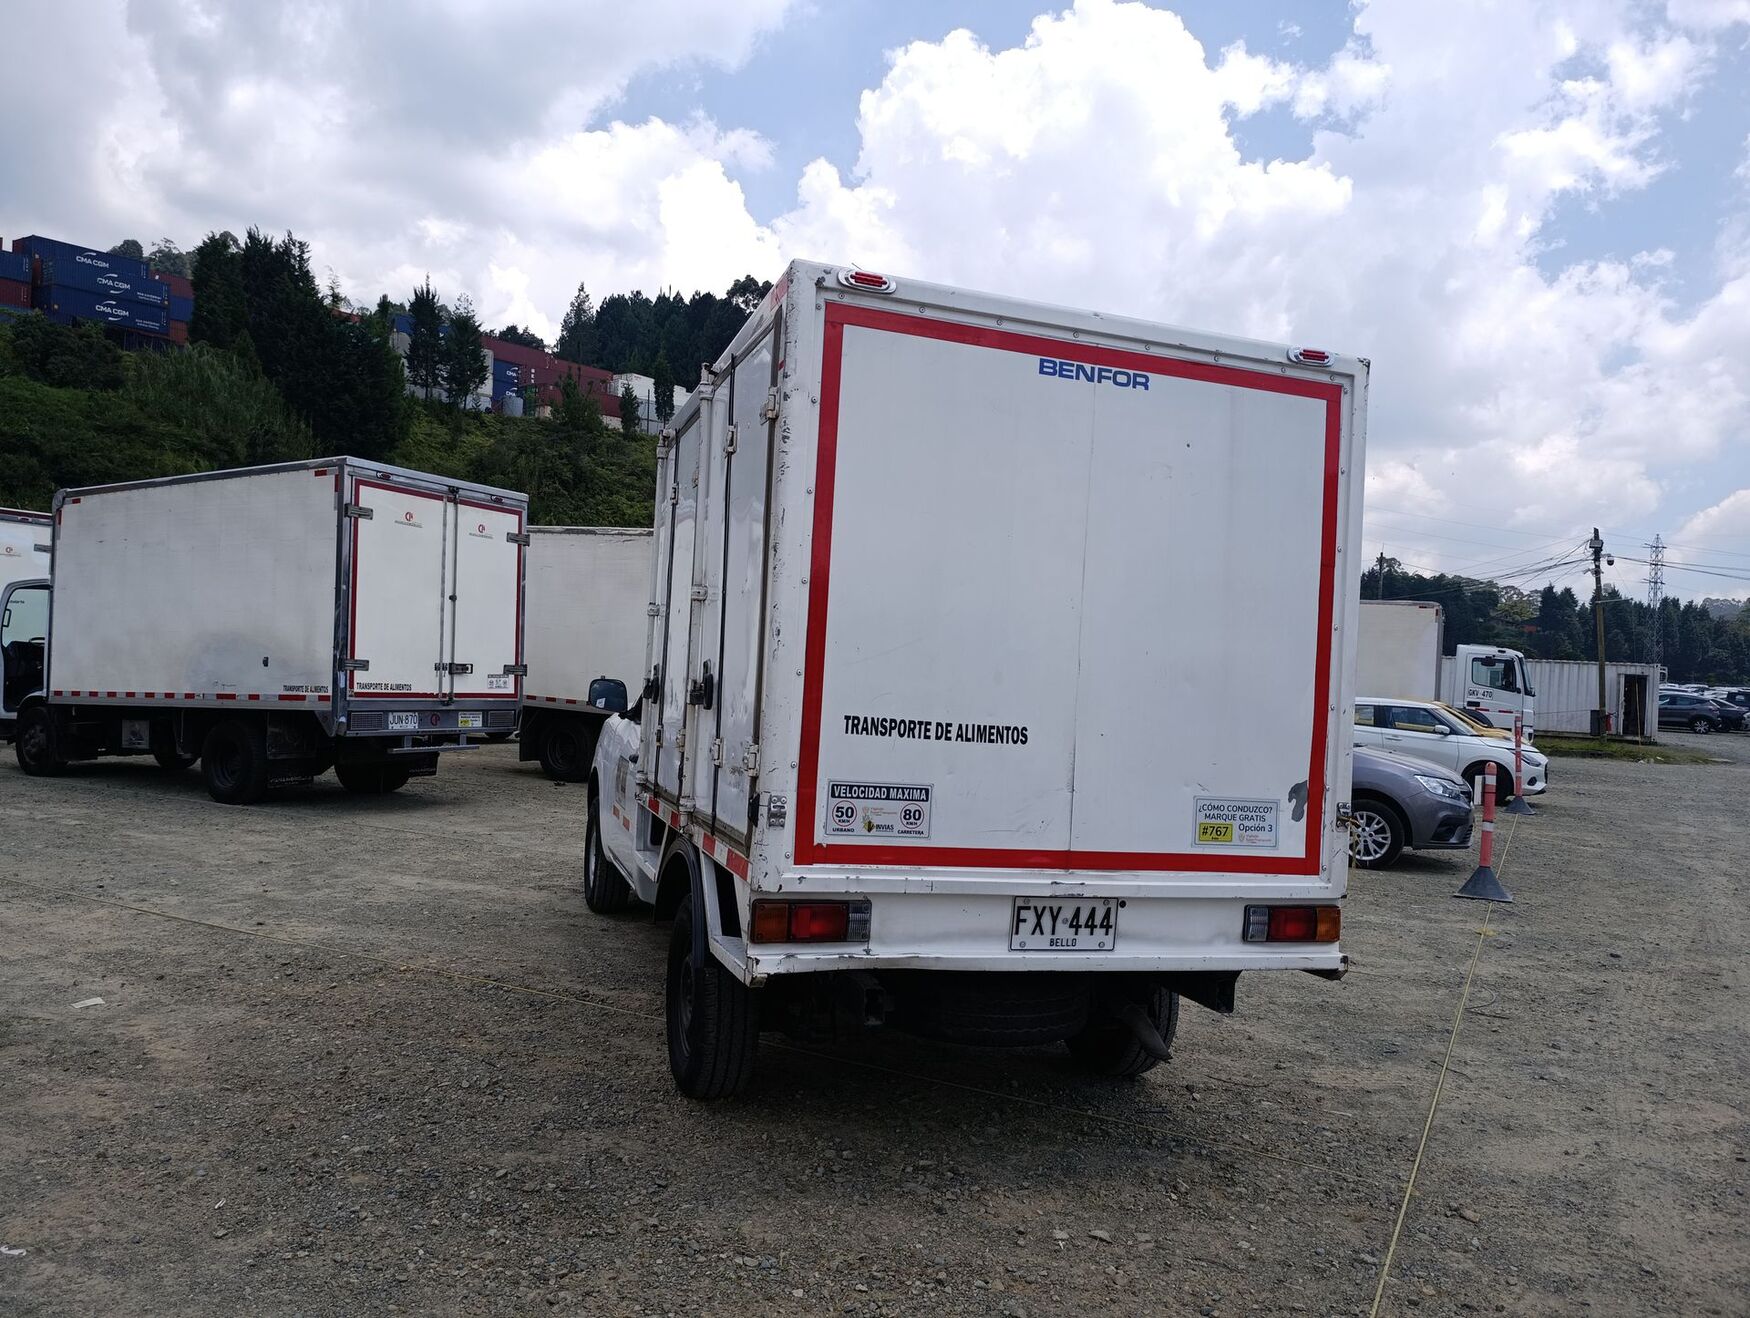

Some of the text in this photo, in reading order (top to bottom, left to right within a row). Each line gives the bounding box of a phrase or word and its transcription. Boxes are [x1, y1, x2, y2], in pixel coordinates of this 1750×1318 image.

[76, 256, 109, 268] CMA CGM
[97, 278, 130, 290] CMA CGM
[95, 305, 129, 317] CMA CGM
[1039, 358, 1150, 391] BENFOR
[356, 682, 412, 691] TRANSPORTE DE ALIMENTOS
[844, 715, 1029, 745] TRANSPORTE DE ALIMENTOS
[834, 785, 927, 800] VELOCIDAD MAXIMA
[835, 806, 855, 818] 50
[1198, 803, 1273, 814] ¿CÓMO CONDUZCO?
[903, 809, 922, 821] 80
[1204, 813, 1266, 823] MARQUE GRATIS
[1202, 825, 1229, 837] #767
[1238, 823, 1273, 833] Opción 3
[1049, 938, 1077, 947] BELLO
